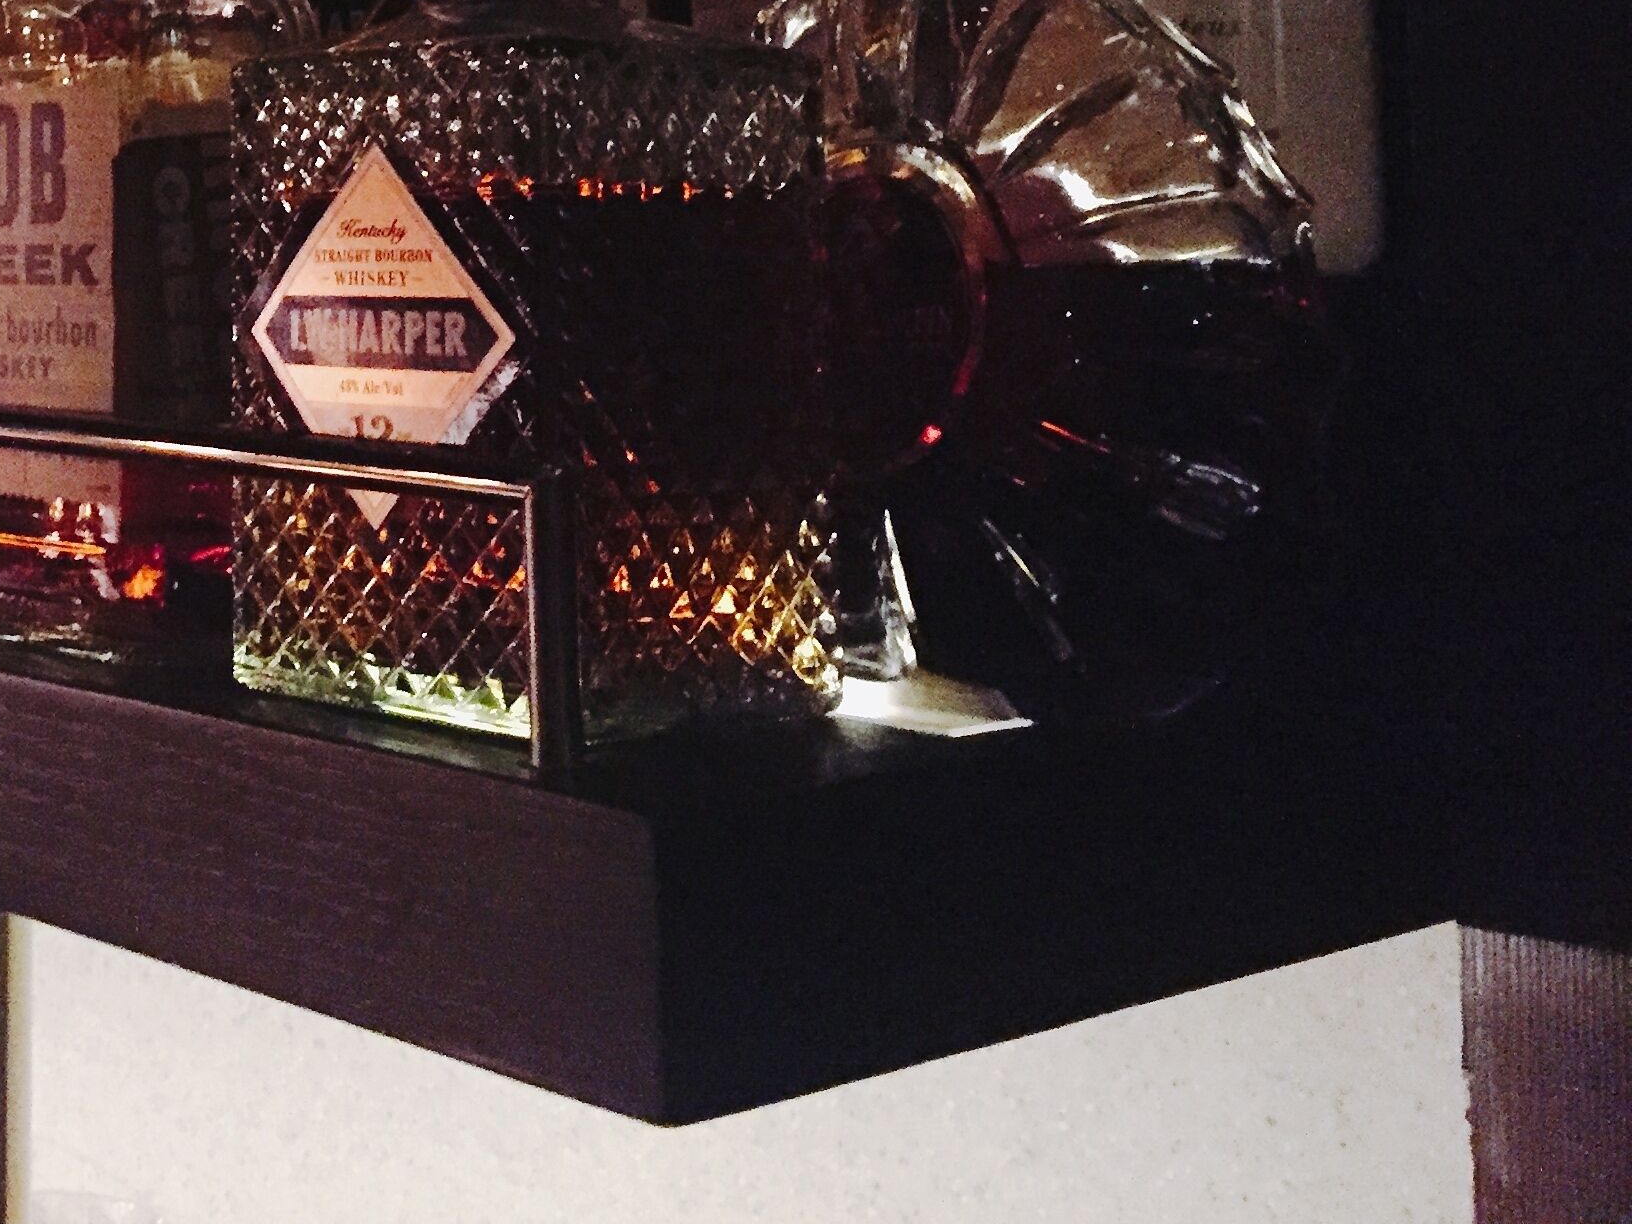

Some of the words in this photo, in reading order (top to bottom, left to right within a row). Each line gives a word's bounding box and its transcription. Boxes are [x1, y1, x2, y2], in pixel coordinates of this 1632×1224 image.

[336, 219, 407, 244] Kentucky
[315, 249, 371, 264] STRAIGHT
[375, 250, 433, 264] BOURBON
[334, 270, 409, 287] WHISKEY
[6, 305, 97, 347] bourbon
[350, 414, 394, 440] 12
